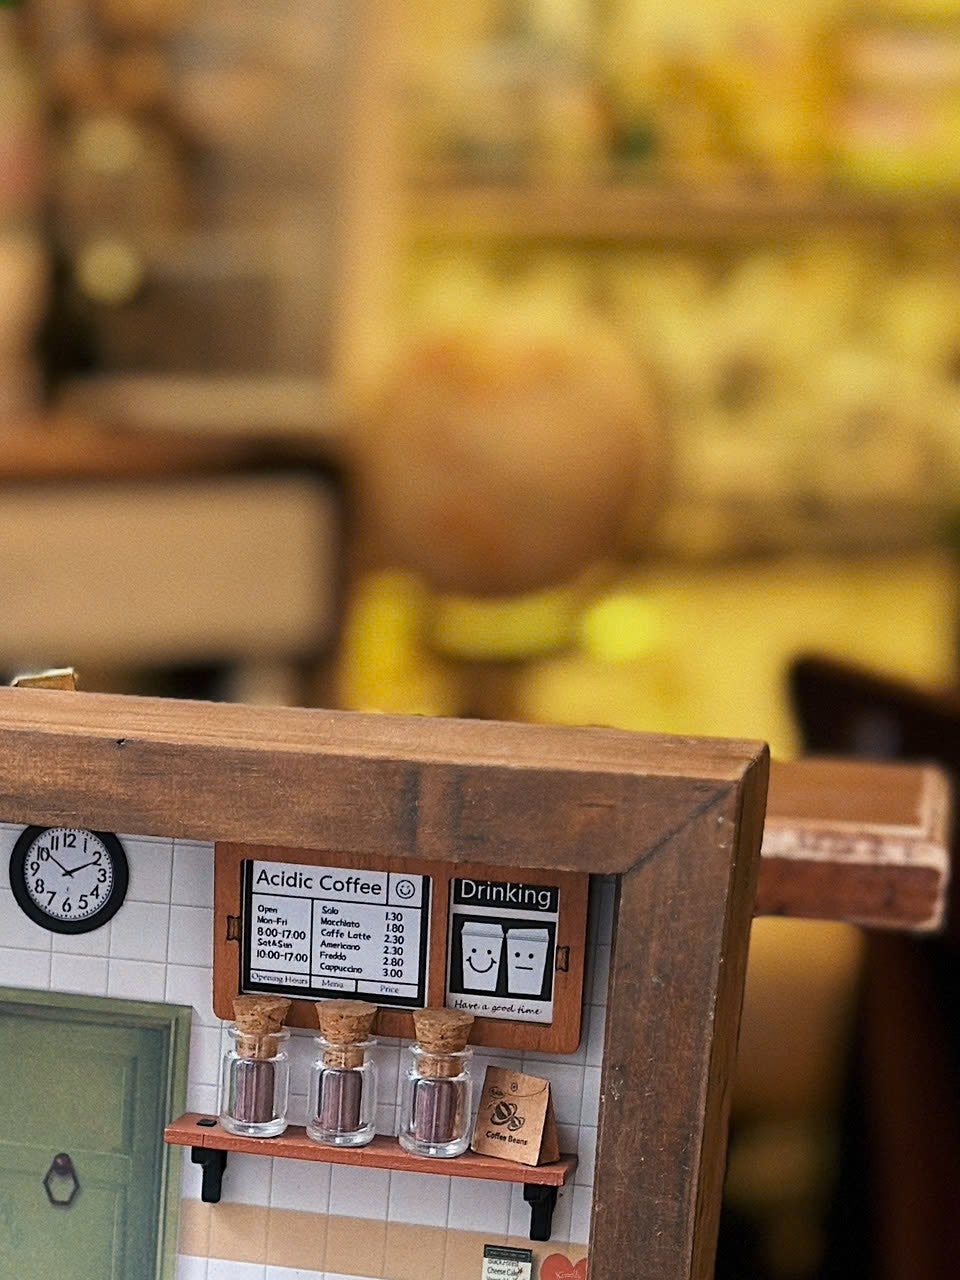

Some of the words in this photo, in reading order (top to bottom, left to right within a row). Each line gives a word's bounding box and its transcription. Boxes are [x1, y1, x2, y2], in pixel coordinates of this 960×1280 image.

[50, 835, 59, 851] 11
[63, 832, 77, 848] 12
[83, 837, 88, 853] 1
[36, 845, 50, 862] 10
[92, 851, 102, 866] 2
[30, 861, 40, 877] 9
[97, 868, 107, 883] 3
[34, 878, 45, 894] 8
[256, 869, 313, 889] Acidic
[319, 875, 382, 895] Coffee
[89, 884, 100, 899] 4
[460, 879, 551, 909] Drinking
[46, 891, 57, 906] 7
[78, 894, 89, 910] 5
[62, 897, 72, 913] 6
[257, 904, 278, 914] Open
[256, 915, 288, 926] Mon-Fri
[320, 917, 360, 929] Macchiato
[385, 912, 403, 922] 1.30
[386, 923, 404, 933] 1.80
[321, 929, 345, 939] Caffe
[347, 931, 372, 941] Latte
[384, 934, 405, 945] 2.30
[257, 938, 293, 949] Sat&Sun
[320, 940, 361, 951] Americano
[319, 951, 347, 961] Freddo
[383, 946, 404, 956] 2.30
[319, 962, 363, 974] Cappuccino
[382, 957, 404, 967] 2.80
[251, 972, 284, 984] Opening
[284, 975, 308, 985] Hours
[382, 968, 403, 978] 3.00
[321, 979, 344, 989] Menu
[380, 985, 400, 994] Price
[454, 999, 479, 1010] Have
[491, 1005, 516, 1014] good
[517, 1005, 541, 1015] time
[486, 1130, 507, 1142] Coffee
[507, 1135, 528, 1146] Beans
[486, 1266, 506, 1275] Cheese
